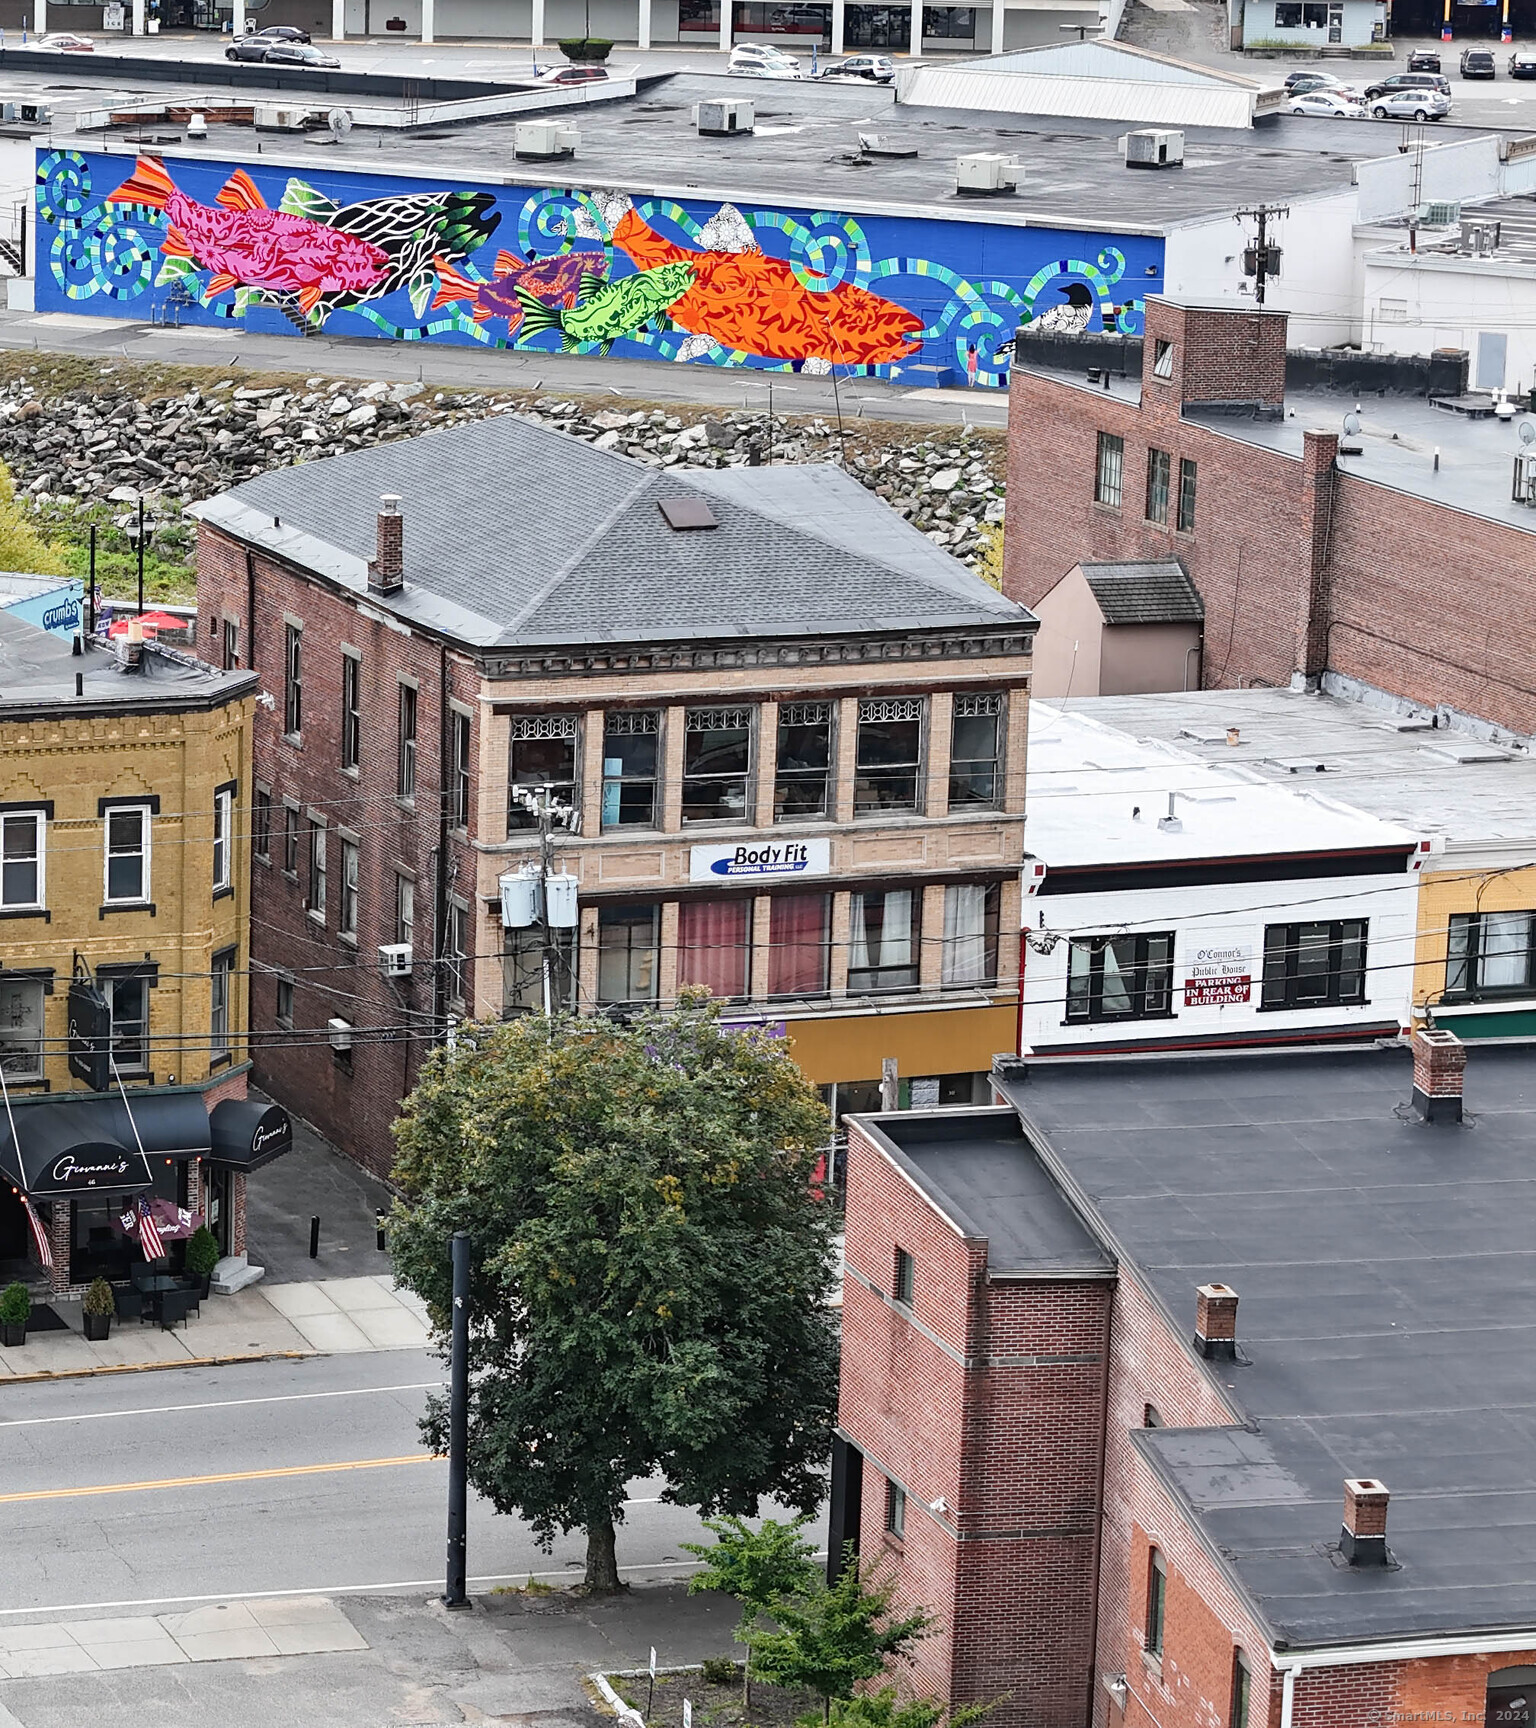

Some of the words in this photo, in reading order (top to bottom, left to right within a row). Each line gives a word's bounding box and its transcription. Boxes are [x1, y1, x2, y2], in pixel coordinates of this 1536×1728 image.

[44, 599, 78, 625] crumbs
[734, 845, 781, 865] Body
[784, 844, 807, 862] Fit
[727, 865, 761, 874] PERSONAL
[763, 864, 794, 872] TRAINING
[1197, 948, 1241, 960] O'Connor's
[1192, 967, 1218, 977] Public
[1194, 977, 1242, 988] PARKING
[1186, 988, 1199, 997] IN
[1202, 986, 1231, 996] REAR
[1234, 984, 1249, 995] OF
[1190, 994, 1244, 1005] BUILDING
[52, 1155, 129, 1181] Giovanni's
